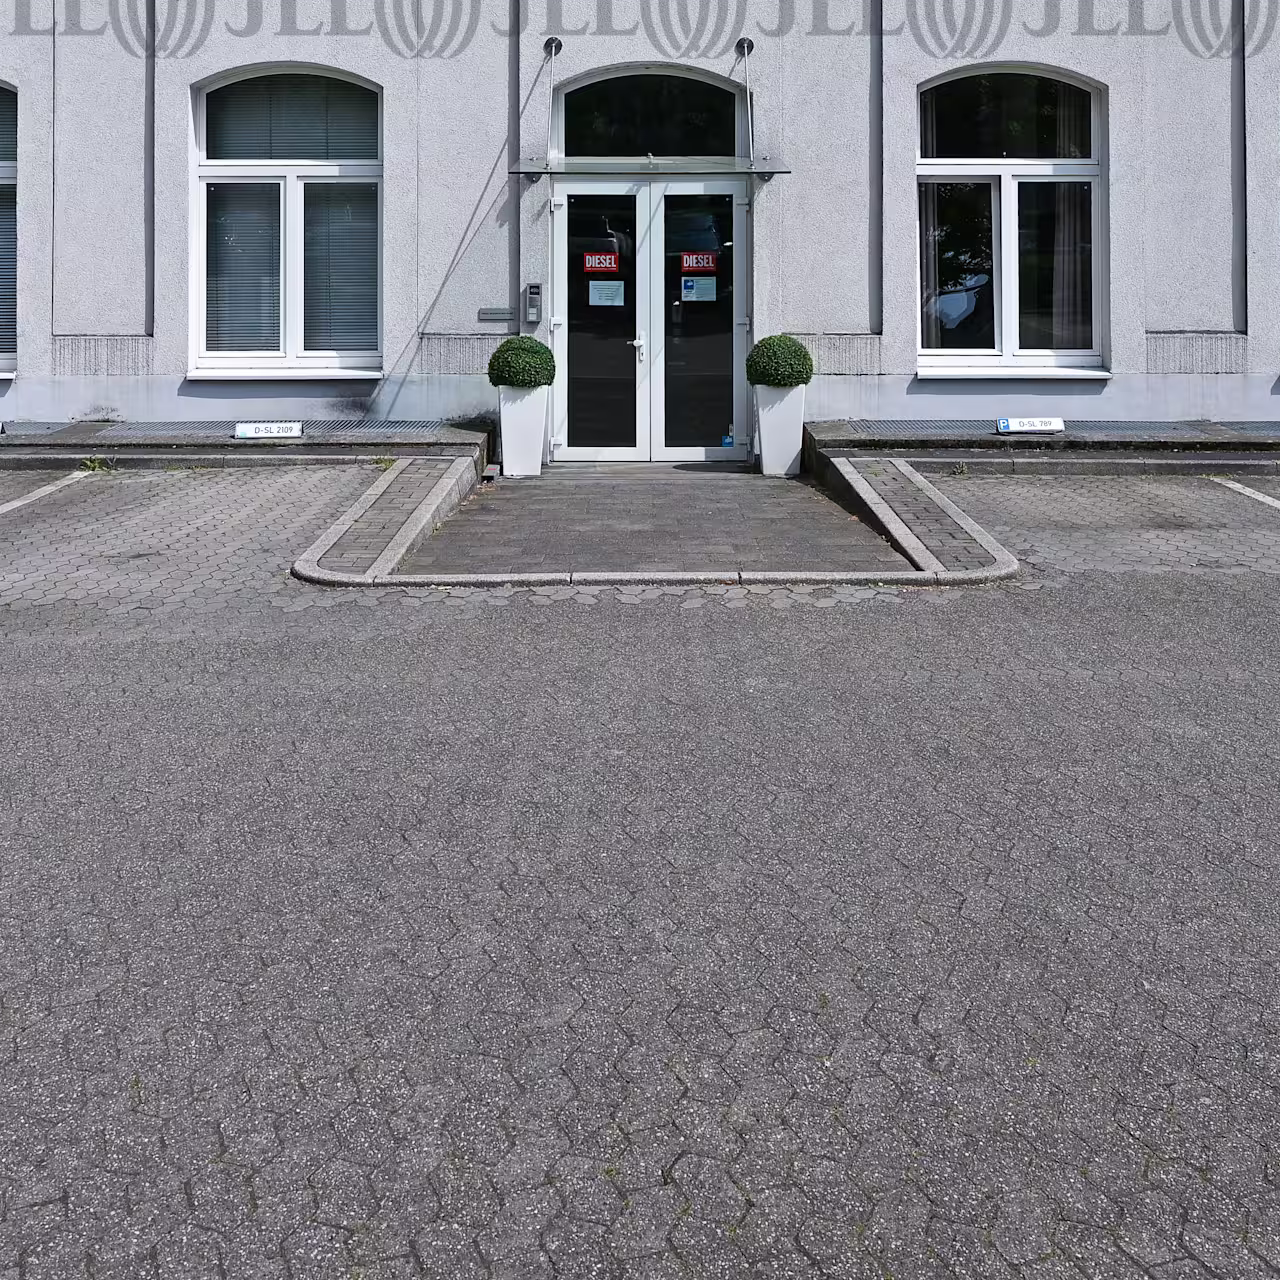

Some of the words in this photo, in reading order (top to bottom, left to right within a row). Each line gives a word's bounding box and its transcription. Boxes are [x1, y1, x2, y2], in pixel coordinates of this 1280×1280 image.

[585, 255, 616, 267] DIESEL
[683, 254, 714, 267] DIESEL
[276, 426, 293, 434] 2109
[999, 419, 1008, 431] P
